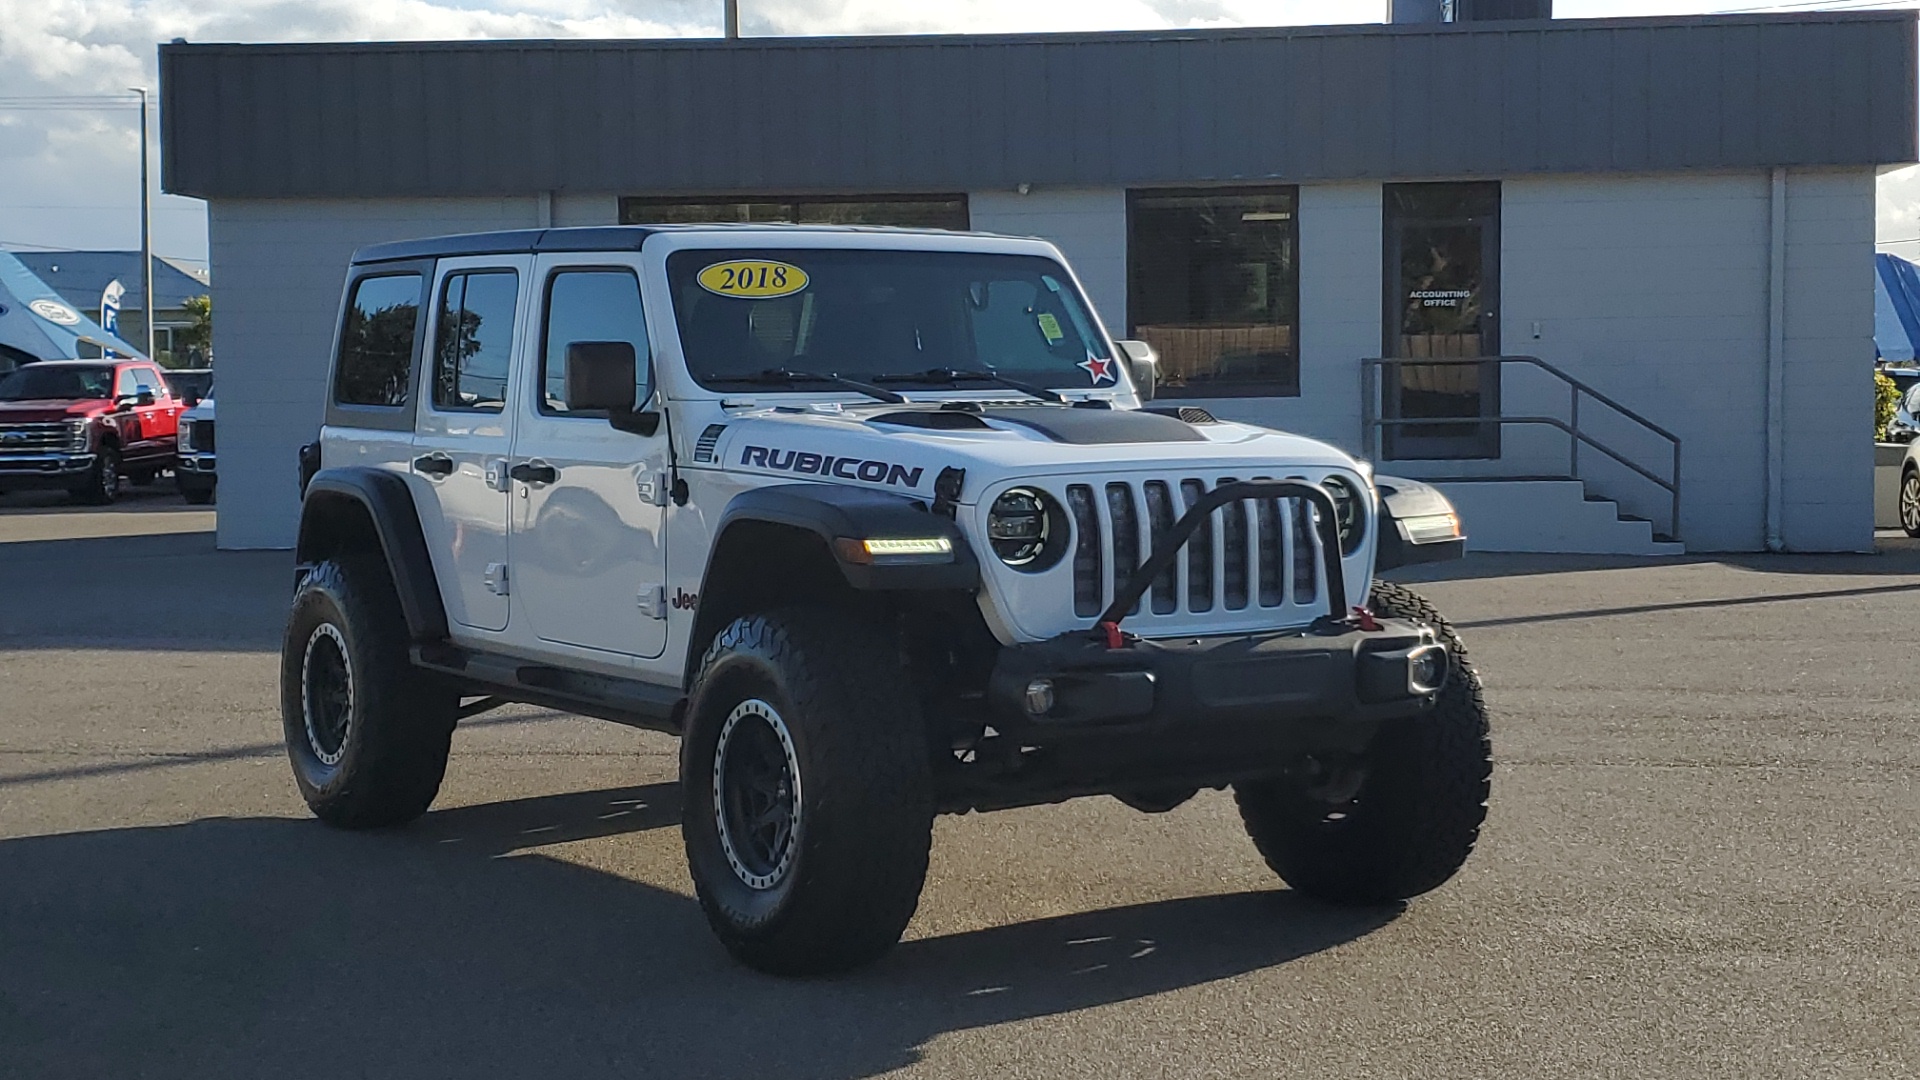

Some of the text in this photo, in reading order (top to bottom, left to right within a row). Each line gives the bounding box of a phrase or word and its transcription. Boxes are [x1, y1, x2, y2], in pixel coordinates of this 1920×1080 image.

[720, 266, 788, 290] 2018
[1409, 290, 1471, 298] ACCOUNTING
[1423, 299, 1457, 307] OFFICE
[740, 445, 924, 488] RUBICON
[672, 586, 698, 611] Jee
